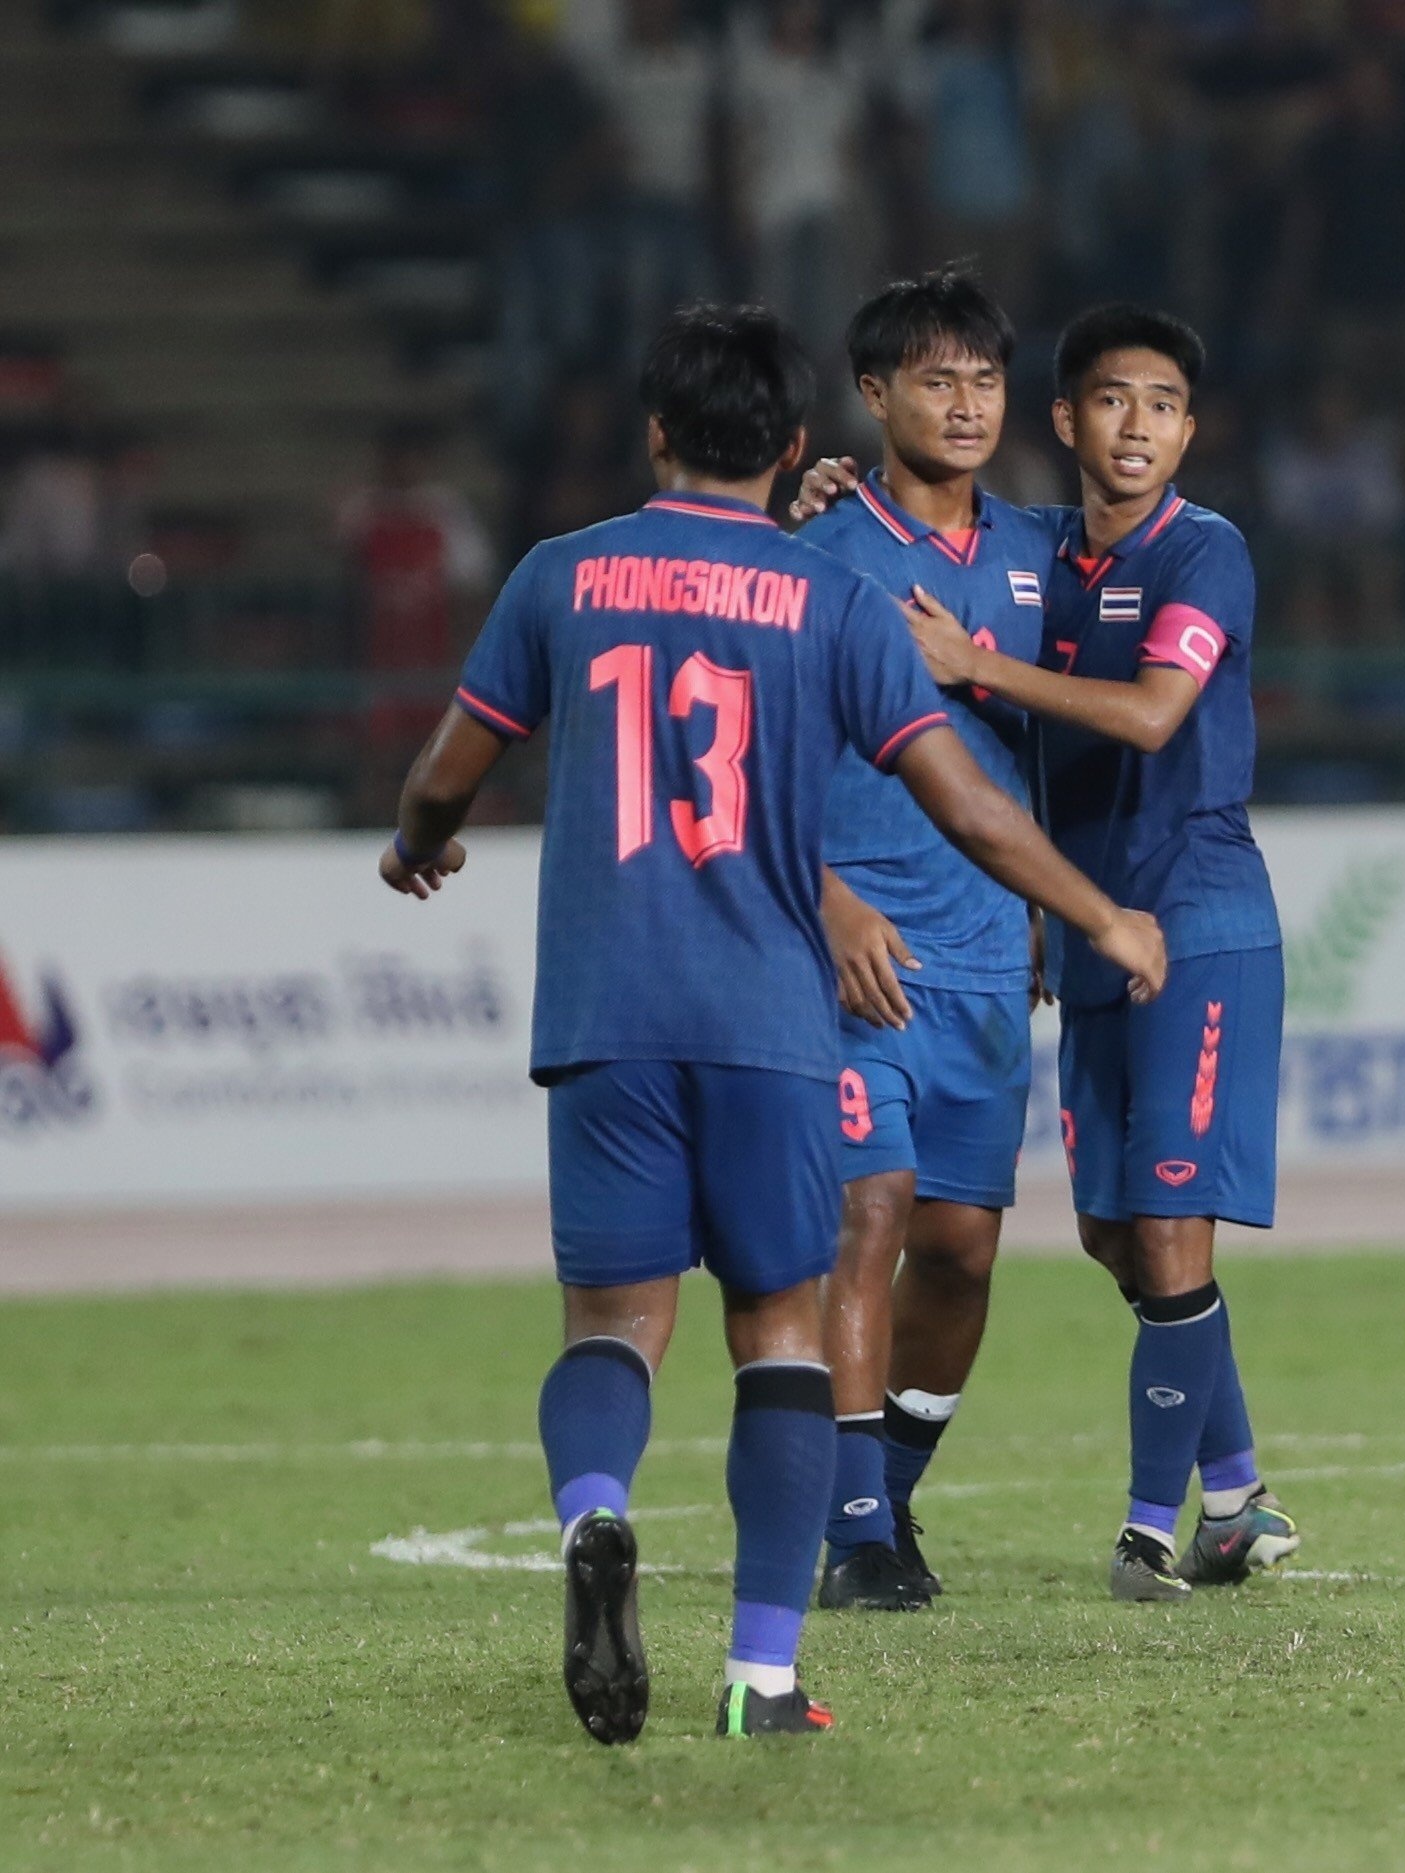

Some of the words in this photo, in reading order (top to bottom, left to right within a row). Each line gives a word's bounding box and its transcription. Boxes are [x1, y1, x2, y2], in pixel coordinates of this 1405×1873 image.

[574, 556, 809, 632] PHONGSAKON
[589, 643, 754, 869] 13
[839, 1067, 874, 1142] 9
